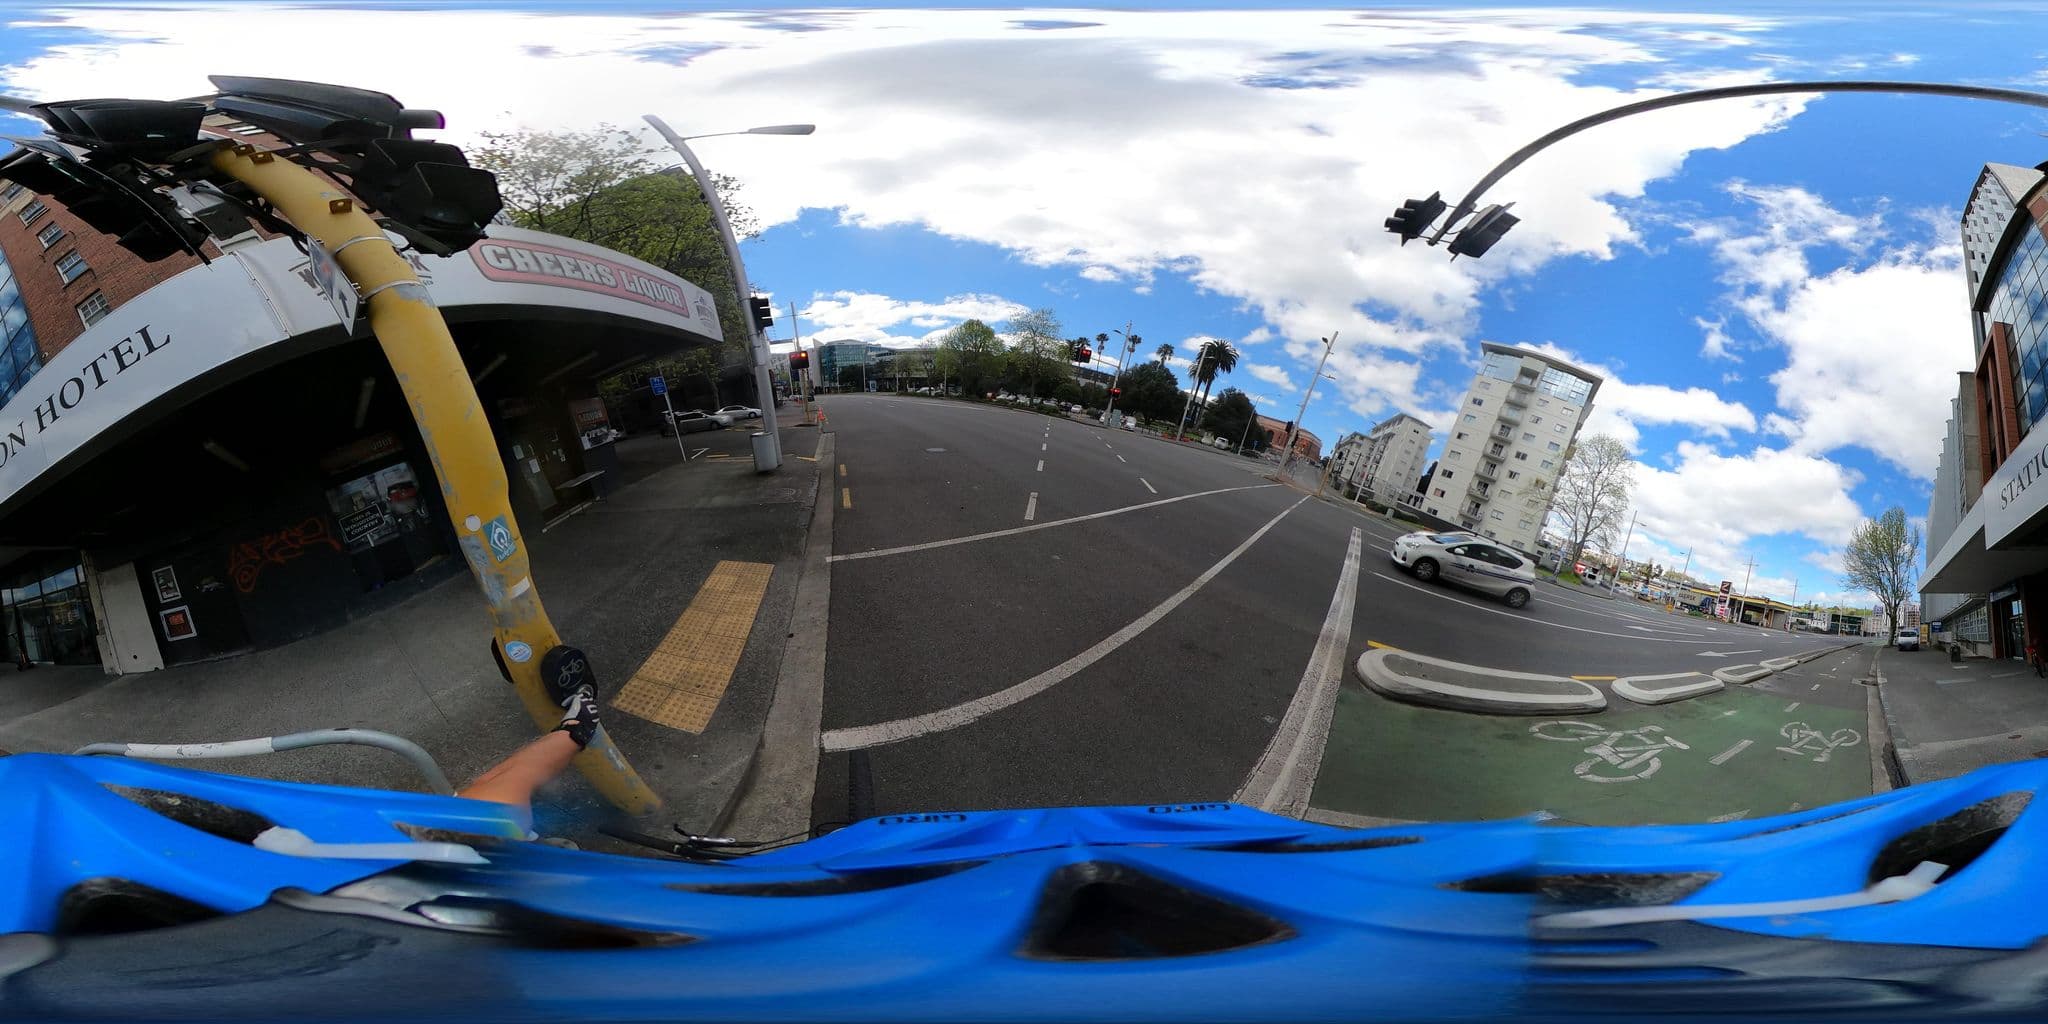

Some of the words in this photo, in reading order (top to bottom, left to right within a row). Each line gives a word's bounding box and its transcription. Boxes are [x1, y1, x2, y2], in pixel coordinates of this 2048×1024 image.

[480, 244, 619, 288] CHEERS
[618, 269, 685, 309] LIQUOR
[34, 324, 171, 434] HOTEL
